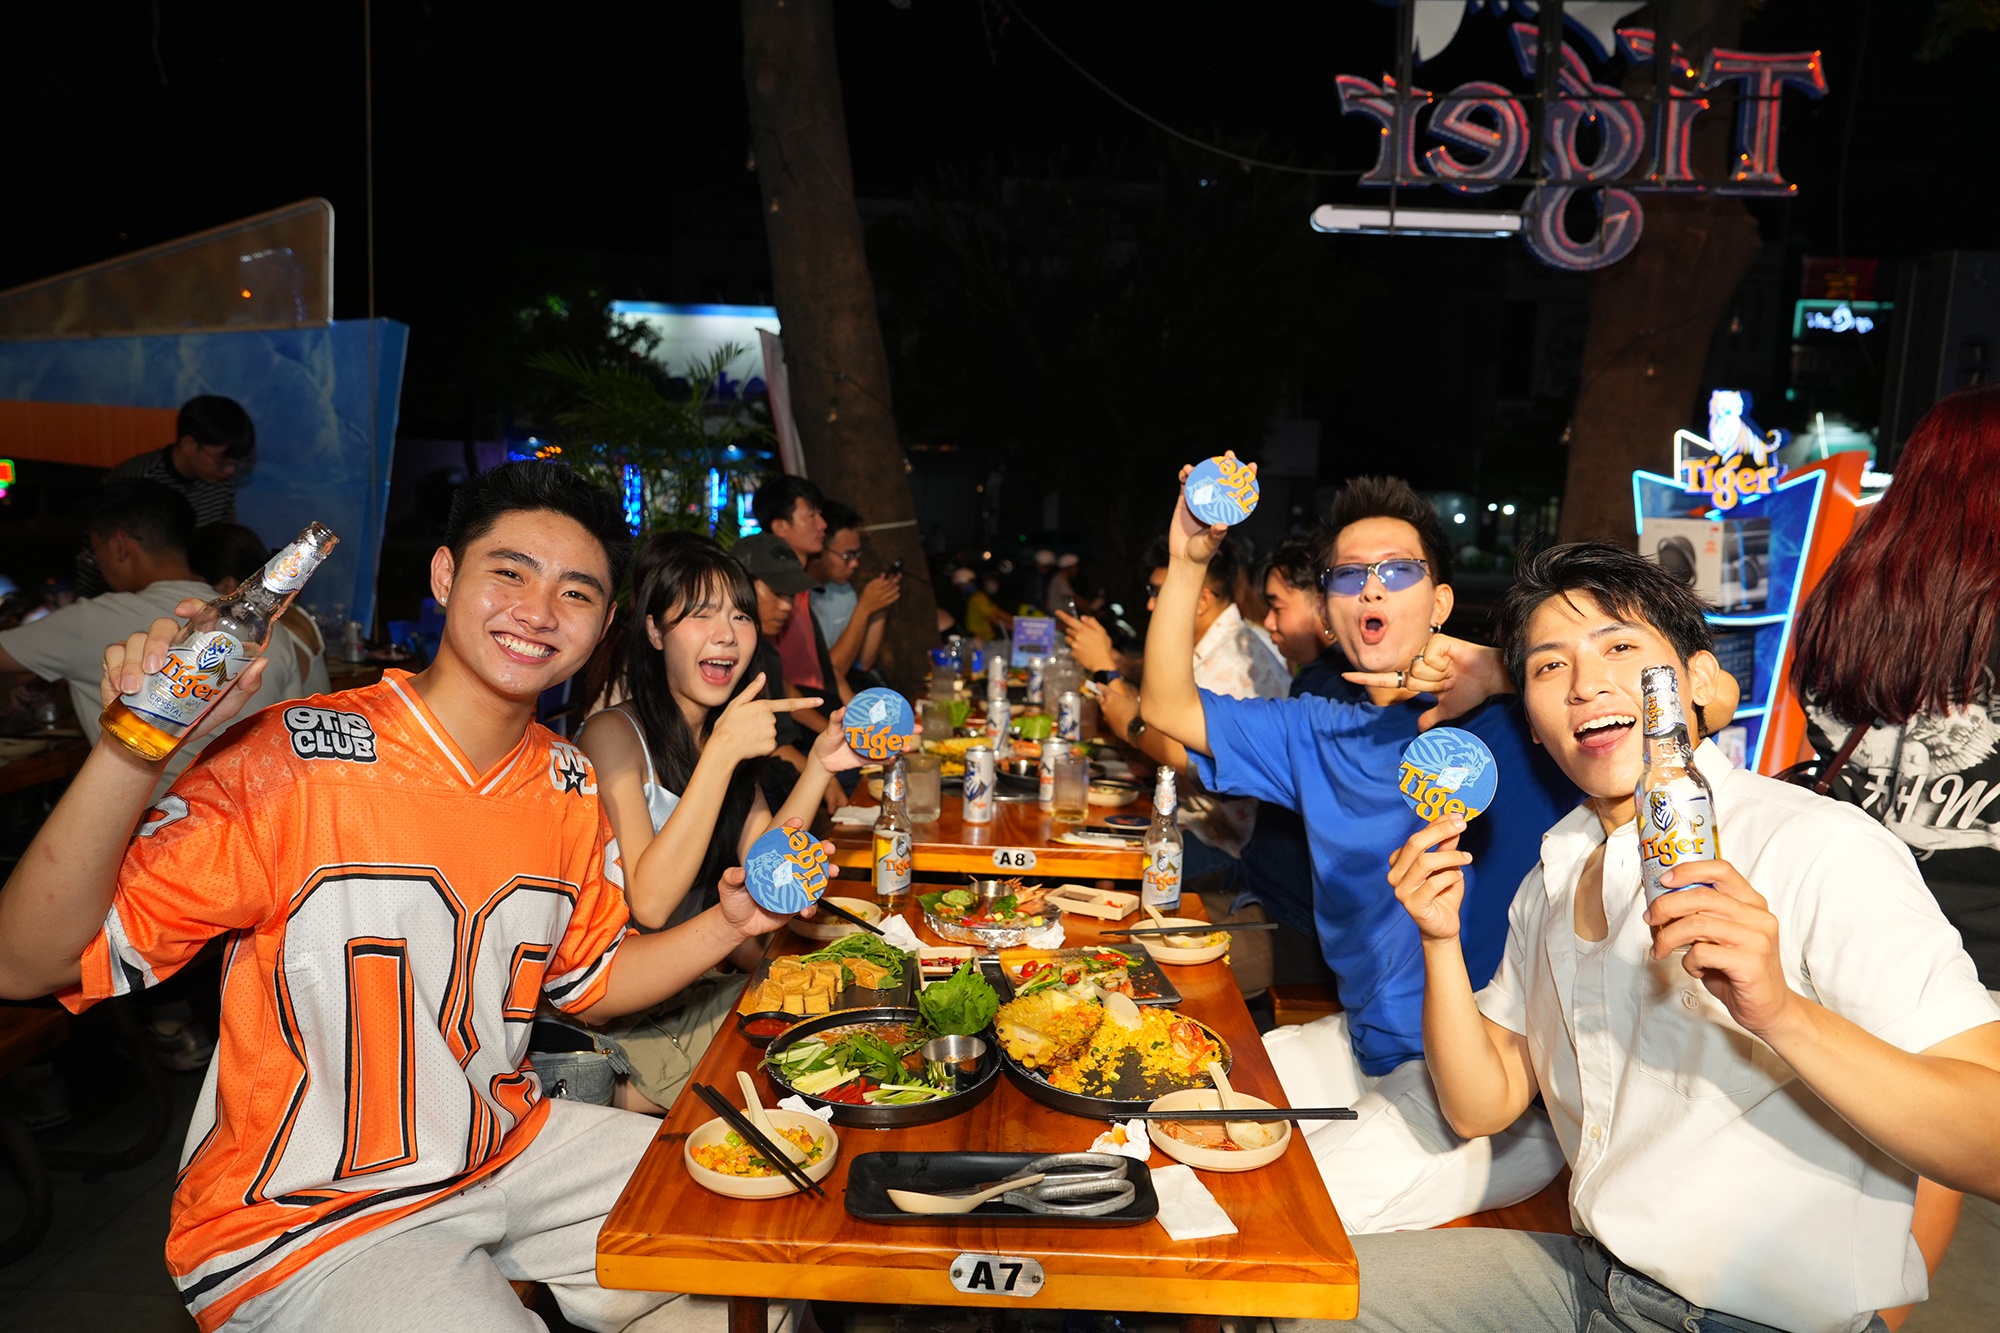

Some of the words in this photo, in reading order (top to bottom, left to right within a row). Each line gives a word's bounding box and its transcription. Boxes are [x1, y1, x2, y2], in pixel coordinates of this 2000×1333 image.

[1680, 454, 1779, 511] Tiger
[269, 551, 304, 582] Tiger
[160, 653, 222, 702] Tiger
[149, 692, 184, 718] CRYSTAL
[1647, 695, 1664, 732] Tiger
[293, 730, 375, 759] CLUB
[845, 724, 913, 759] Tiger
[1400, 761, 1483, 823] Tiger
[1000, 851, 1025, 867] A8
[1641, 831, 1705, 867] Tiger
[1147, 871, 1180, 891] Tiger
[967, 1261, 1023, 1291] A7
